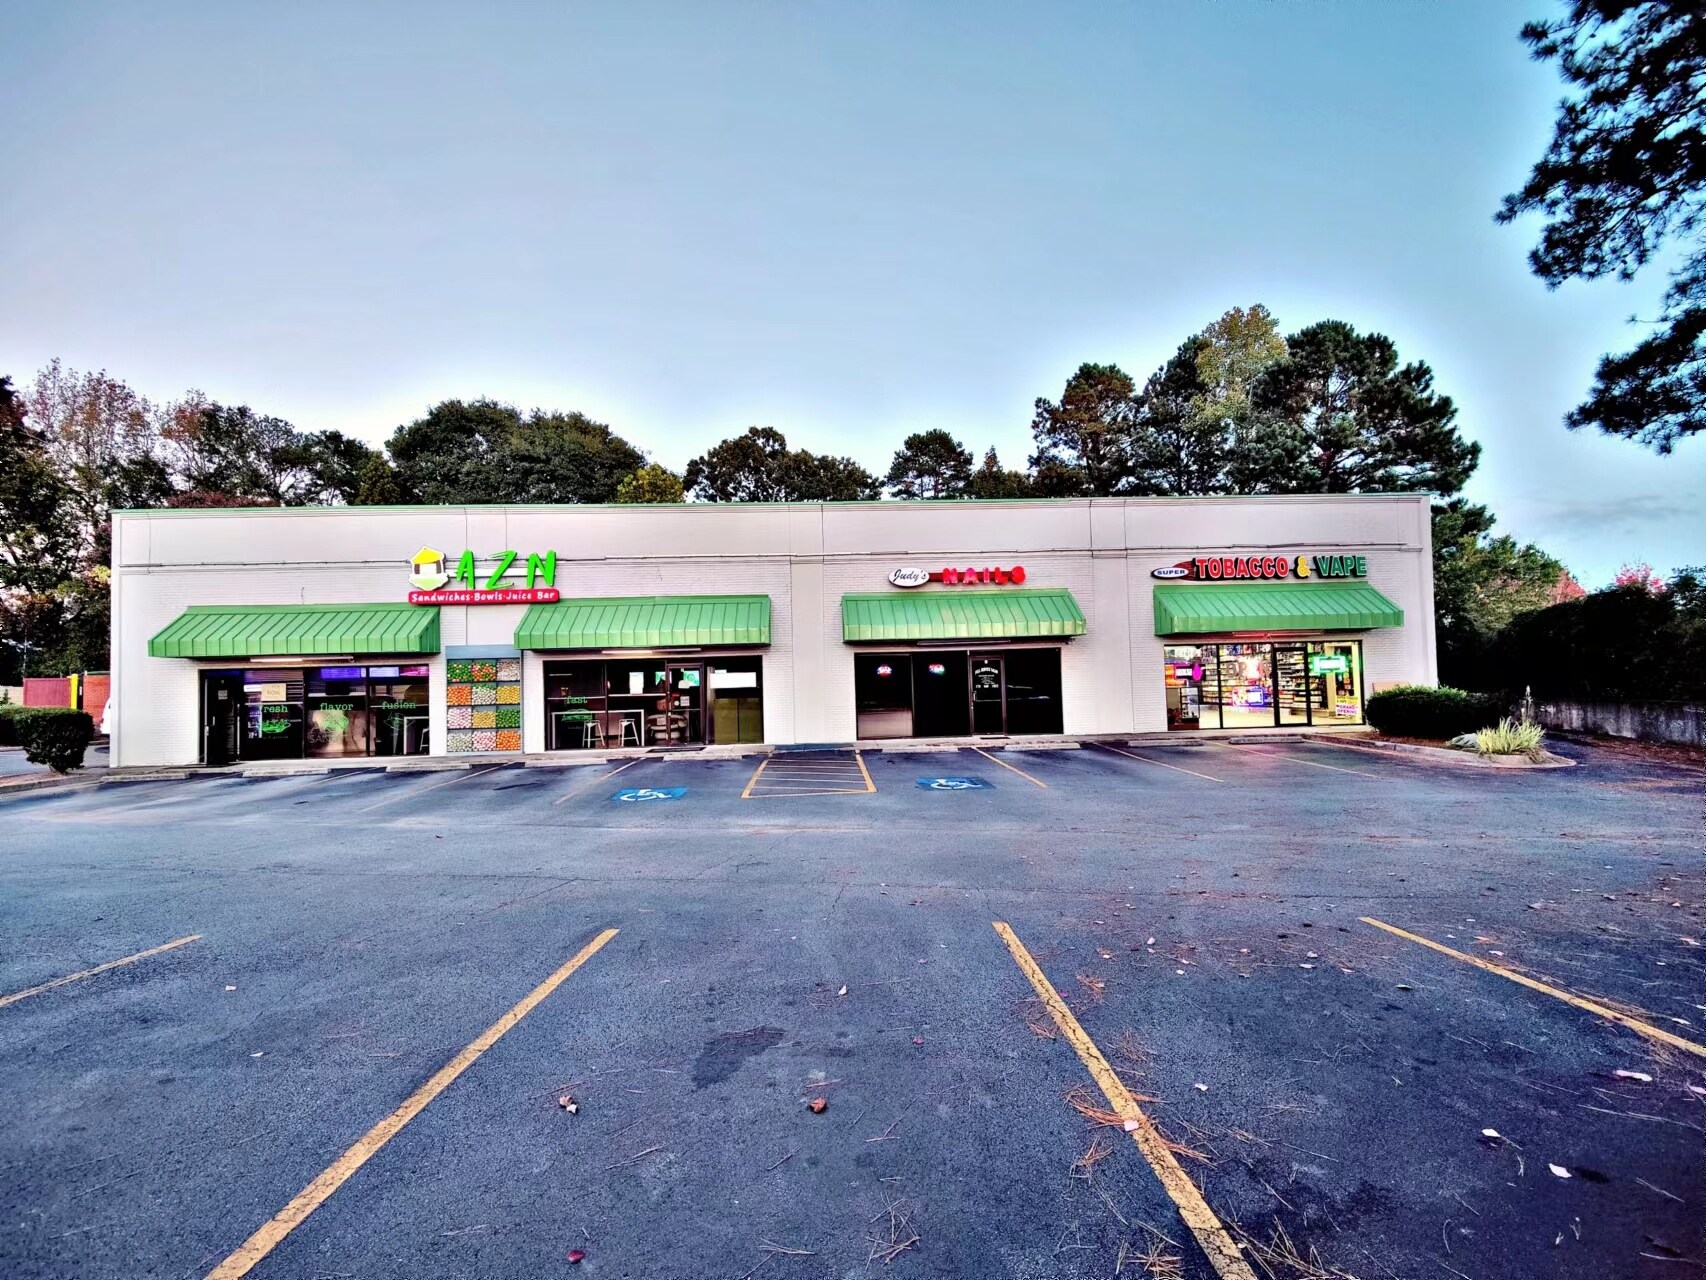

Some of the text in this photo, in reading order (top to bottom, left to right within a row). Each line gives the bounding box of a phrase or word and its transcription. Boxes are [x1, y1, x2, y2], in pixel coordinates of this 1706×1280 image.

[455, 548, 556, 590] AZN
[1195, 556, 1289, 579] TOBACCO
[1296, 555, 1312, 578] &
[1315, 556, 1368, 577] VAPE
[893, 566, 1026, 585] Judy's NAILS
[506, 591, 532, 601] Juice
[537, 591, 555, 599] Bar
[566, 695, 588, 704] fast
[319, 702, 354, 711] flavor
[381, 700, 417, 710] fusion
